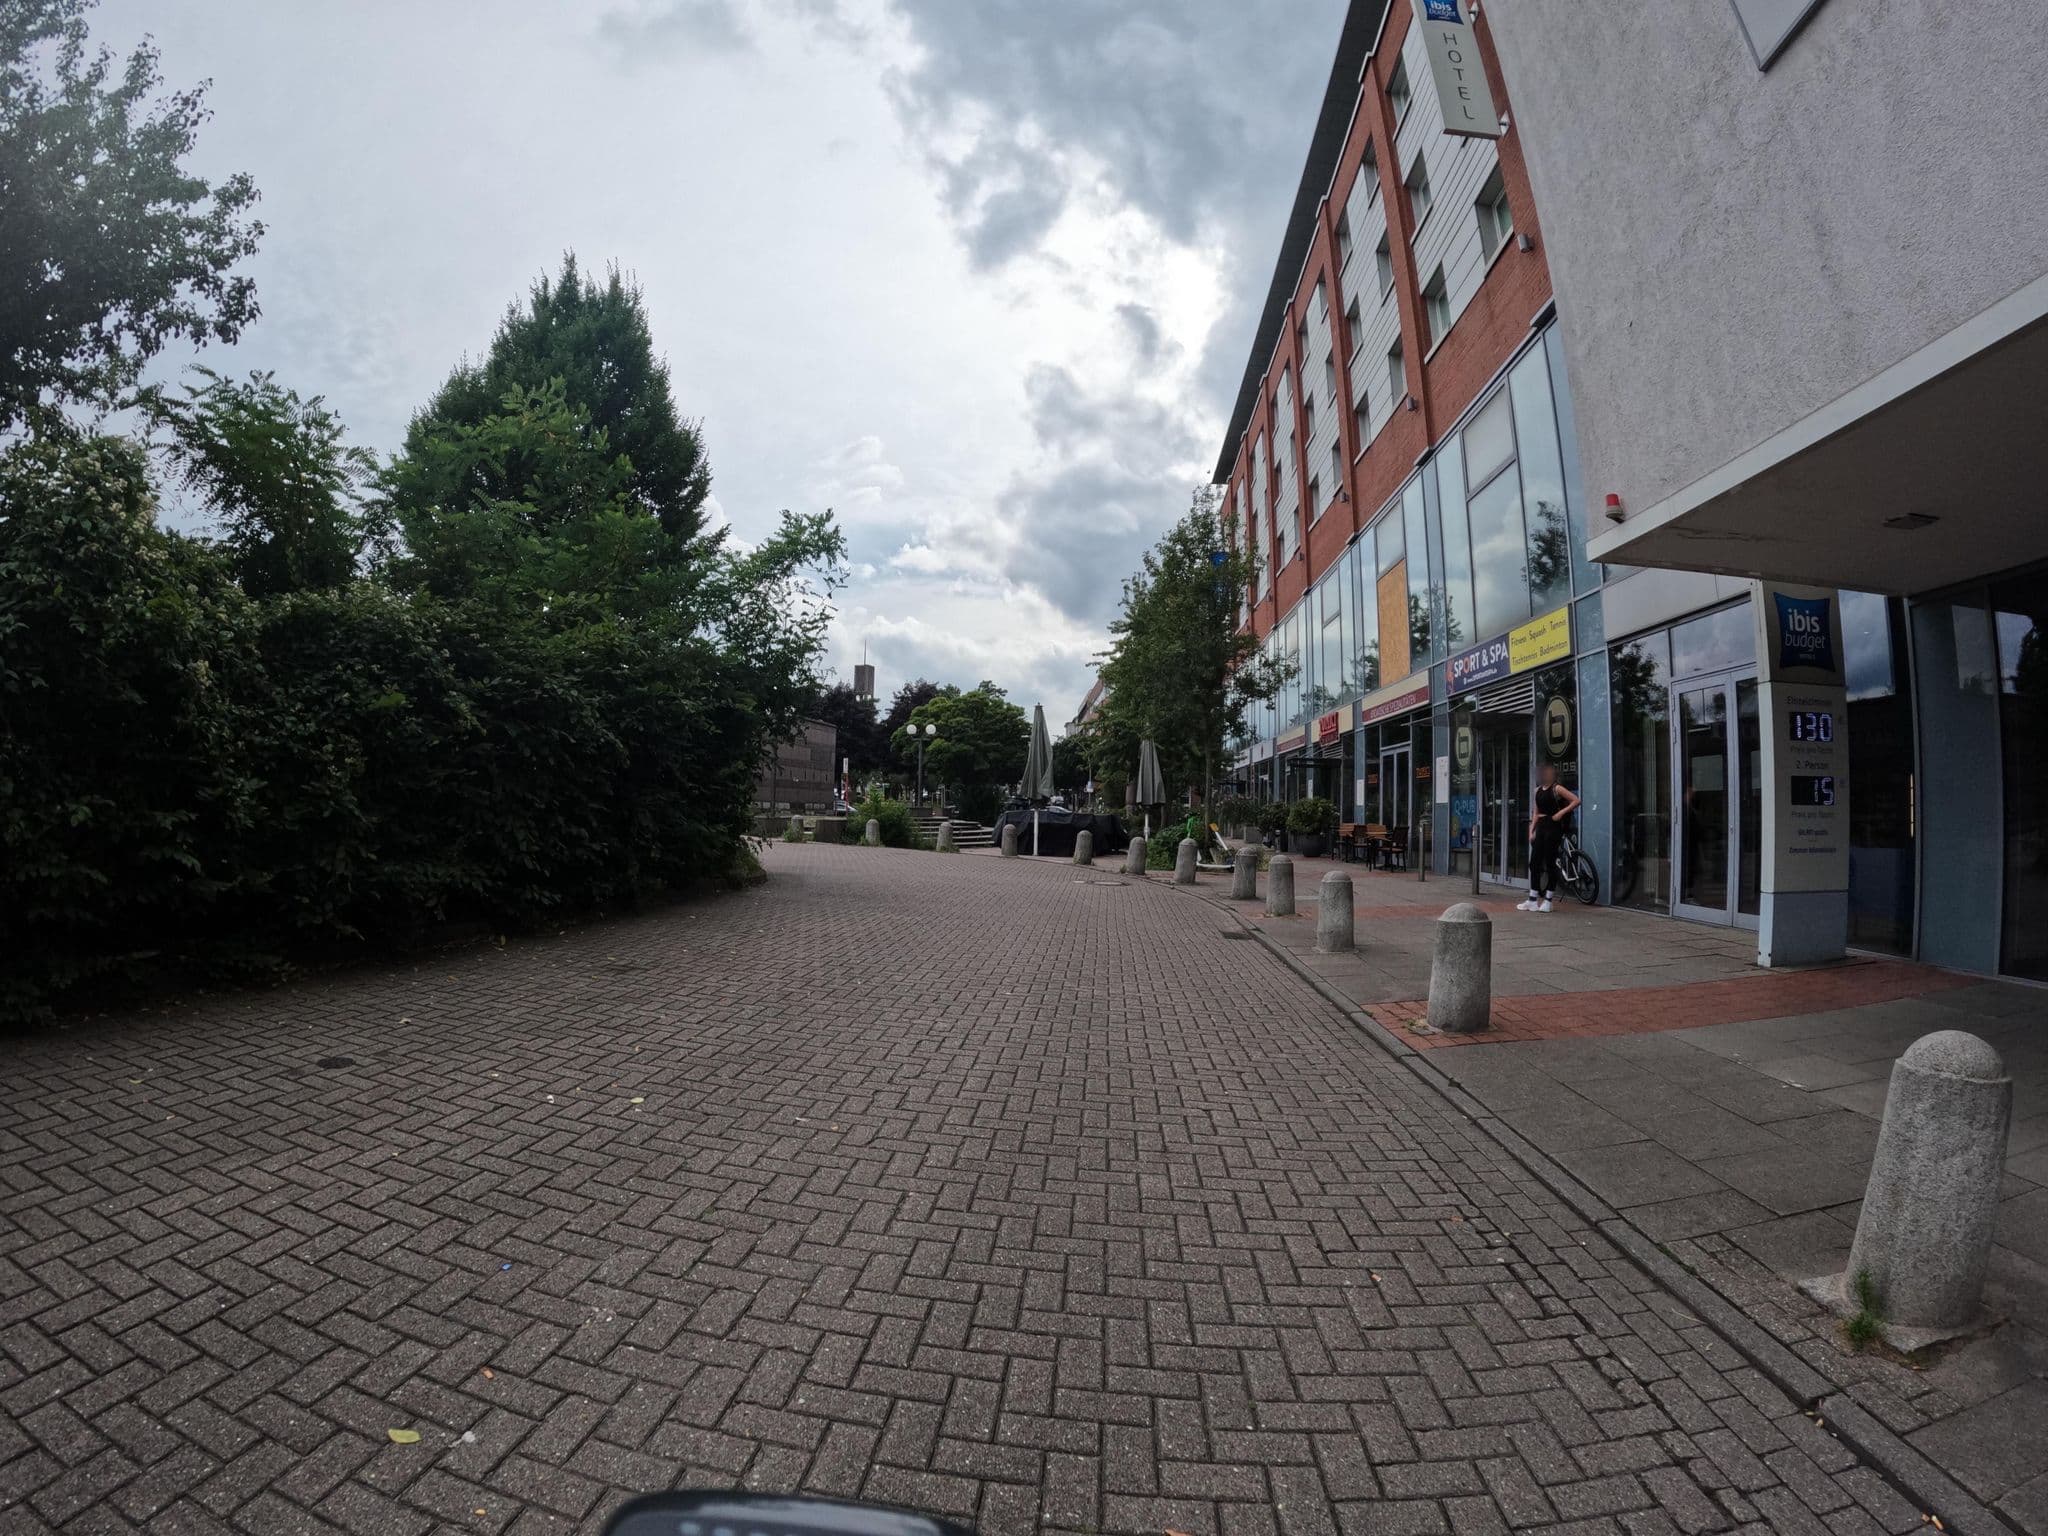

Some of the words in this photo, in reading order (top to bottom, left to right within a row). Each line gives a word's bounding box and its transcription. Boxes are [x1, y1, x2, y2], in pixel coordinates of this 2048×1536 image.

[1428, 9, 1456, 17] budget
[1442, 31, 1476, 120] HOTEL
[1788, 608, 1820, 632] ibis
[1528, 624, 1547, 641] Squash
[1784, 631, 1826, 650] budget
[1539, 640, 1568, 657] Badminton
[1454, 655, 1480, 678] SPORT
[1481, 649, 1489, 666] &
[1490, 641, 1509, 664] SPA
[1796, 713, 1833, 741] 130
[1804, 760, 1828, 769] Person
[1813, 777, 1834, 806] 15
